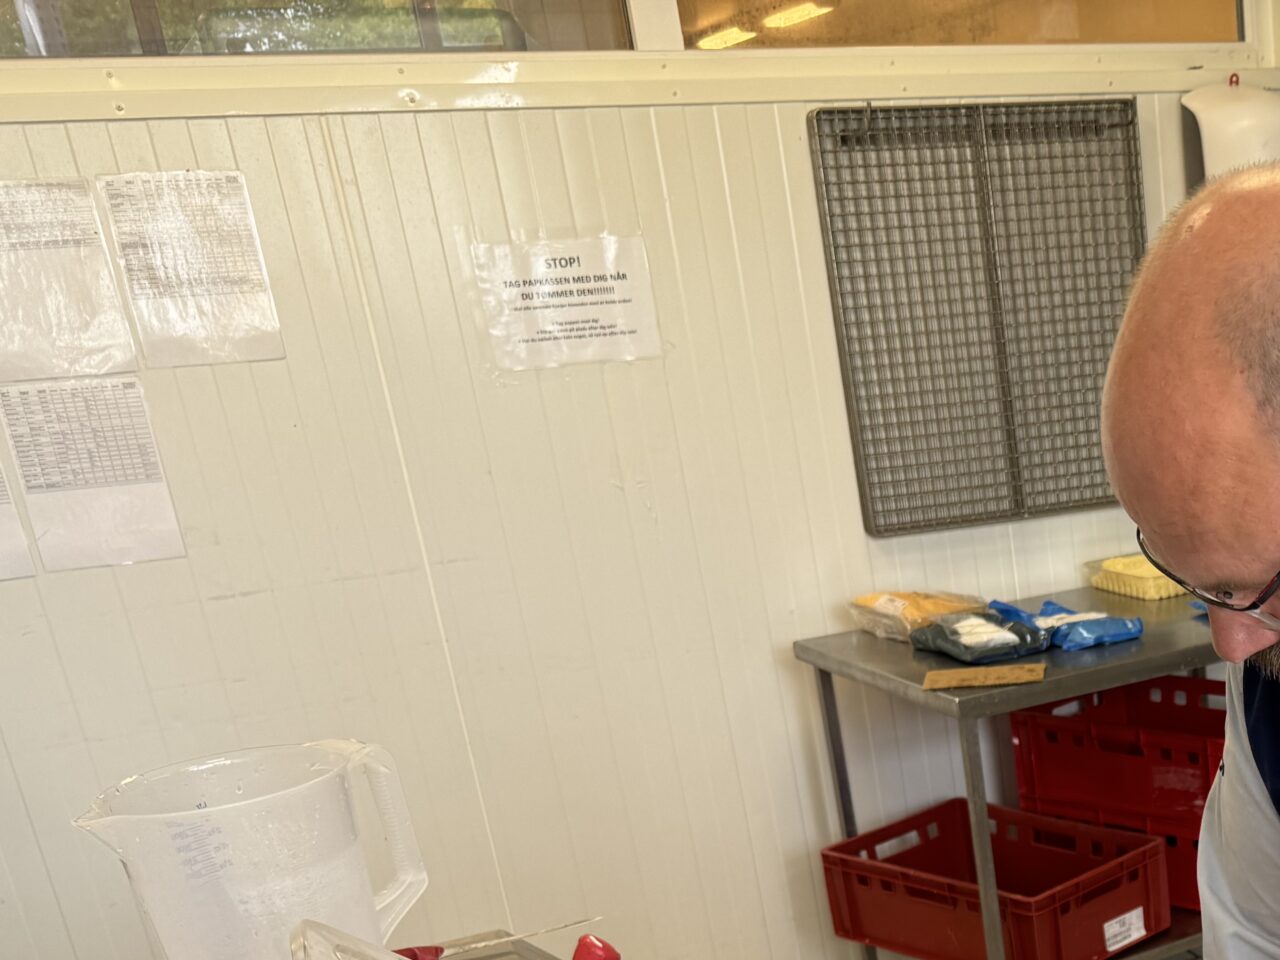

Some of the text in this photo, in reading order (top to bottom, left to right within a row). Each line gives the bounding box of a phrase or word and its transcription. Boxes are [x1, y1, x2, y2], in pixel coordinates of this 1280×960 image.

[544, 255, 581, 269] STOP!
[503, 270, 628, 289] TAG PAPKASSEN MED DIG NÅR
[521, 292, 534, 301] DU
